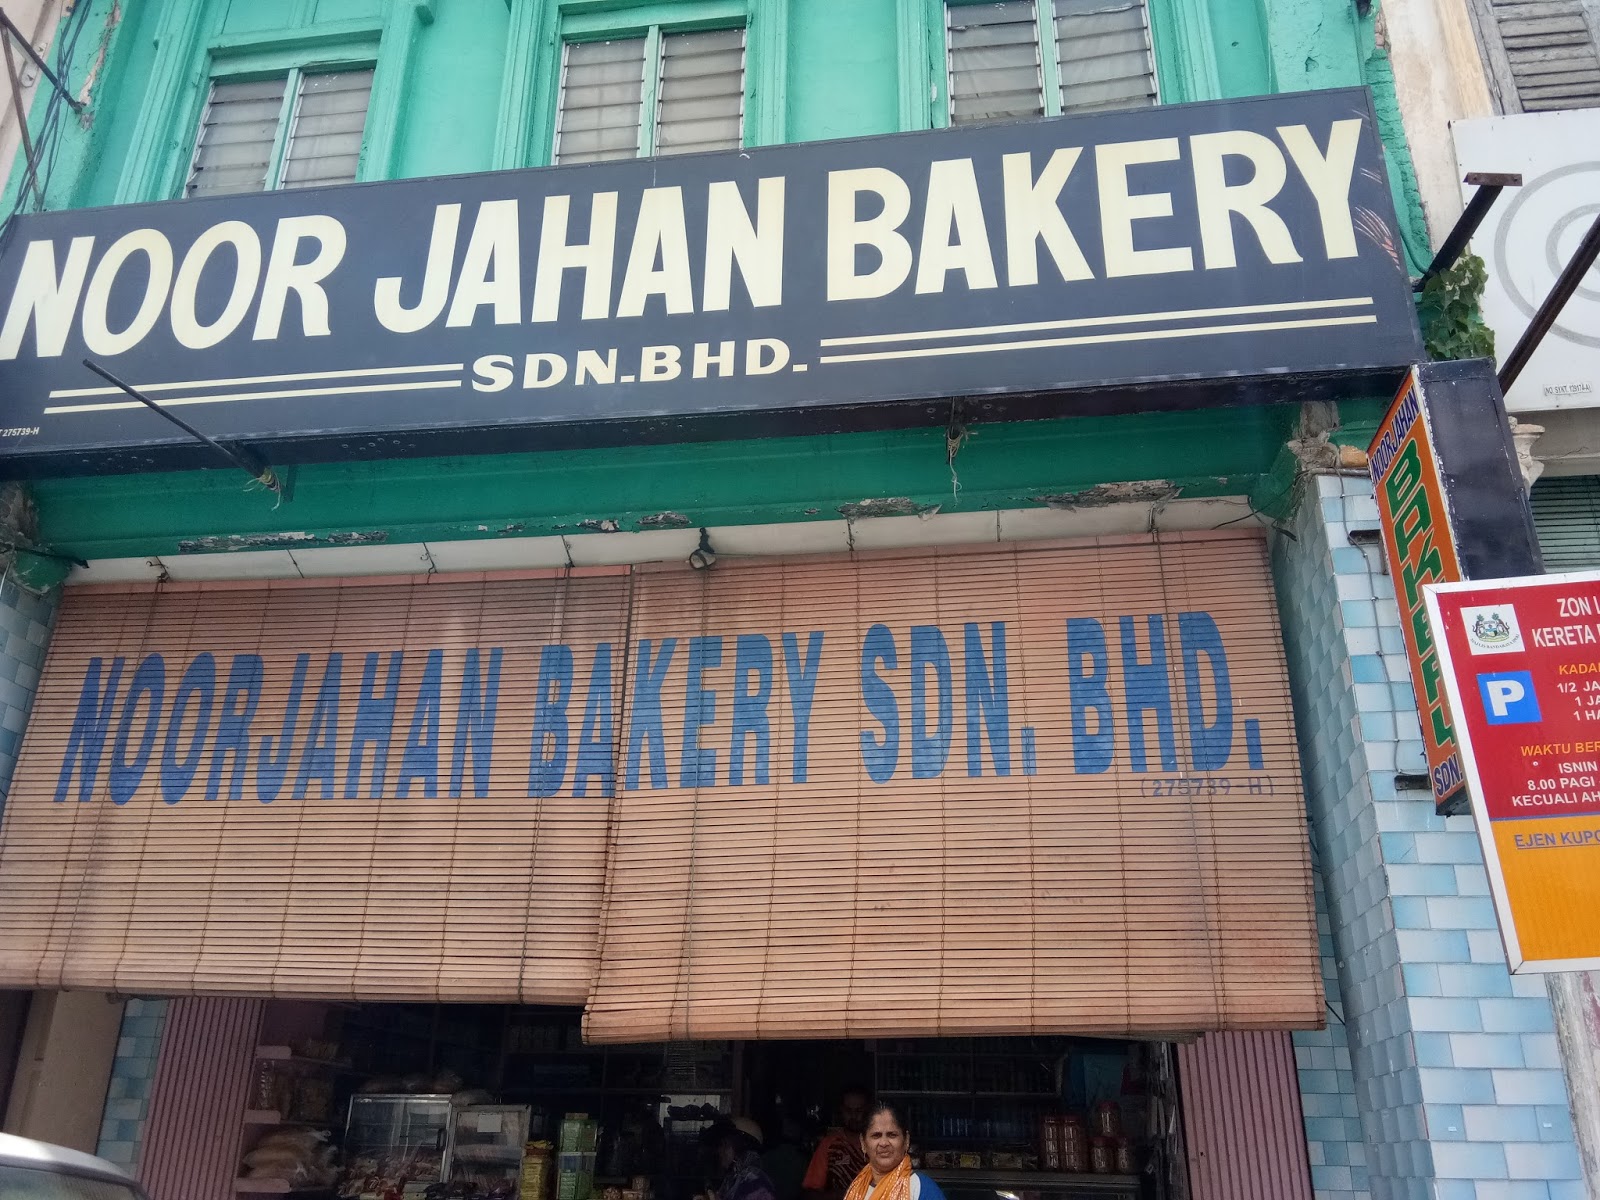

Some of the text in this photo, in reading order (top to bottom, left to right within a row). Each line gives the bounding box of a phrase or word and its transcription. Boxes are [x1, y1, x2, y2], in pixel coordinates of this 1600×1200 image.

[0, 119, 1362, 361] NOOR JAHAN BAKERY
[2, 426, 40, 437] 275739-H
[1370, 384, 1421, 485] NOORJAHAN
[1556, 596, 1592, 618] ZON
[1531, 624, 1597, 648] KERETA
[1557, 682, 1578, 693] 1/2
[1486, 679, 1525, 717] P
[1574, 695, 1582, 707] 1
[55, 610, 1265, 805] NOORJAHAN BAKERY SDN. BHD.
[1573, 710, 1581, 721] 1
[1520, 742, 1571, 757] WAKTU
[1558, 760, 1598, 774] ISNIN
[1527, 776, 1596, 791] 8.00 PAGI
[1511, 792, 1578, 807] KECUALI
[1514, 832, 1557, 847] EJEN
